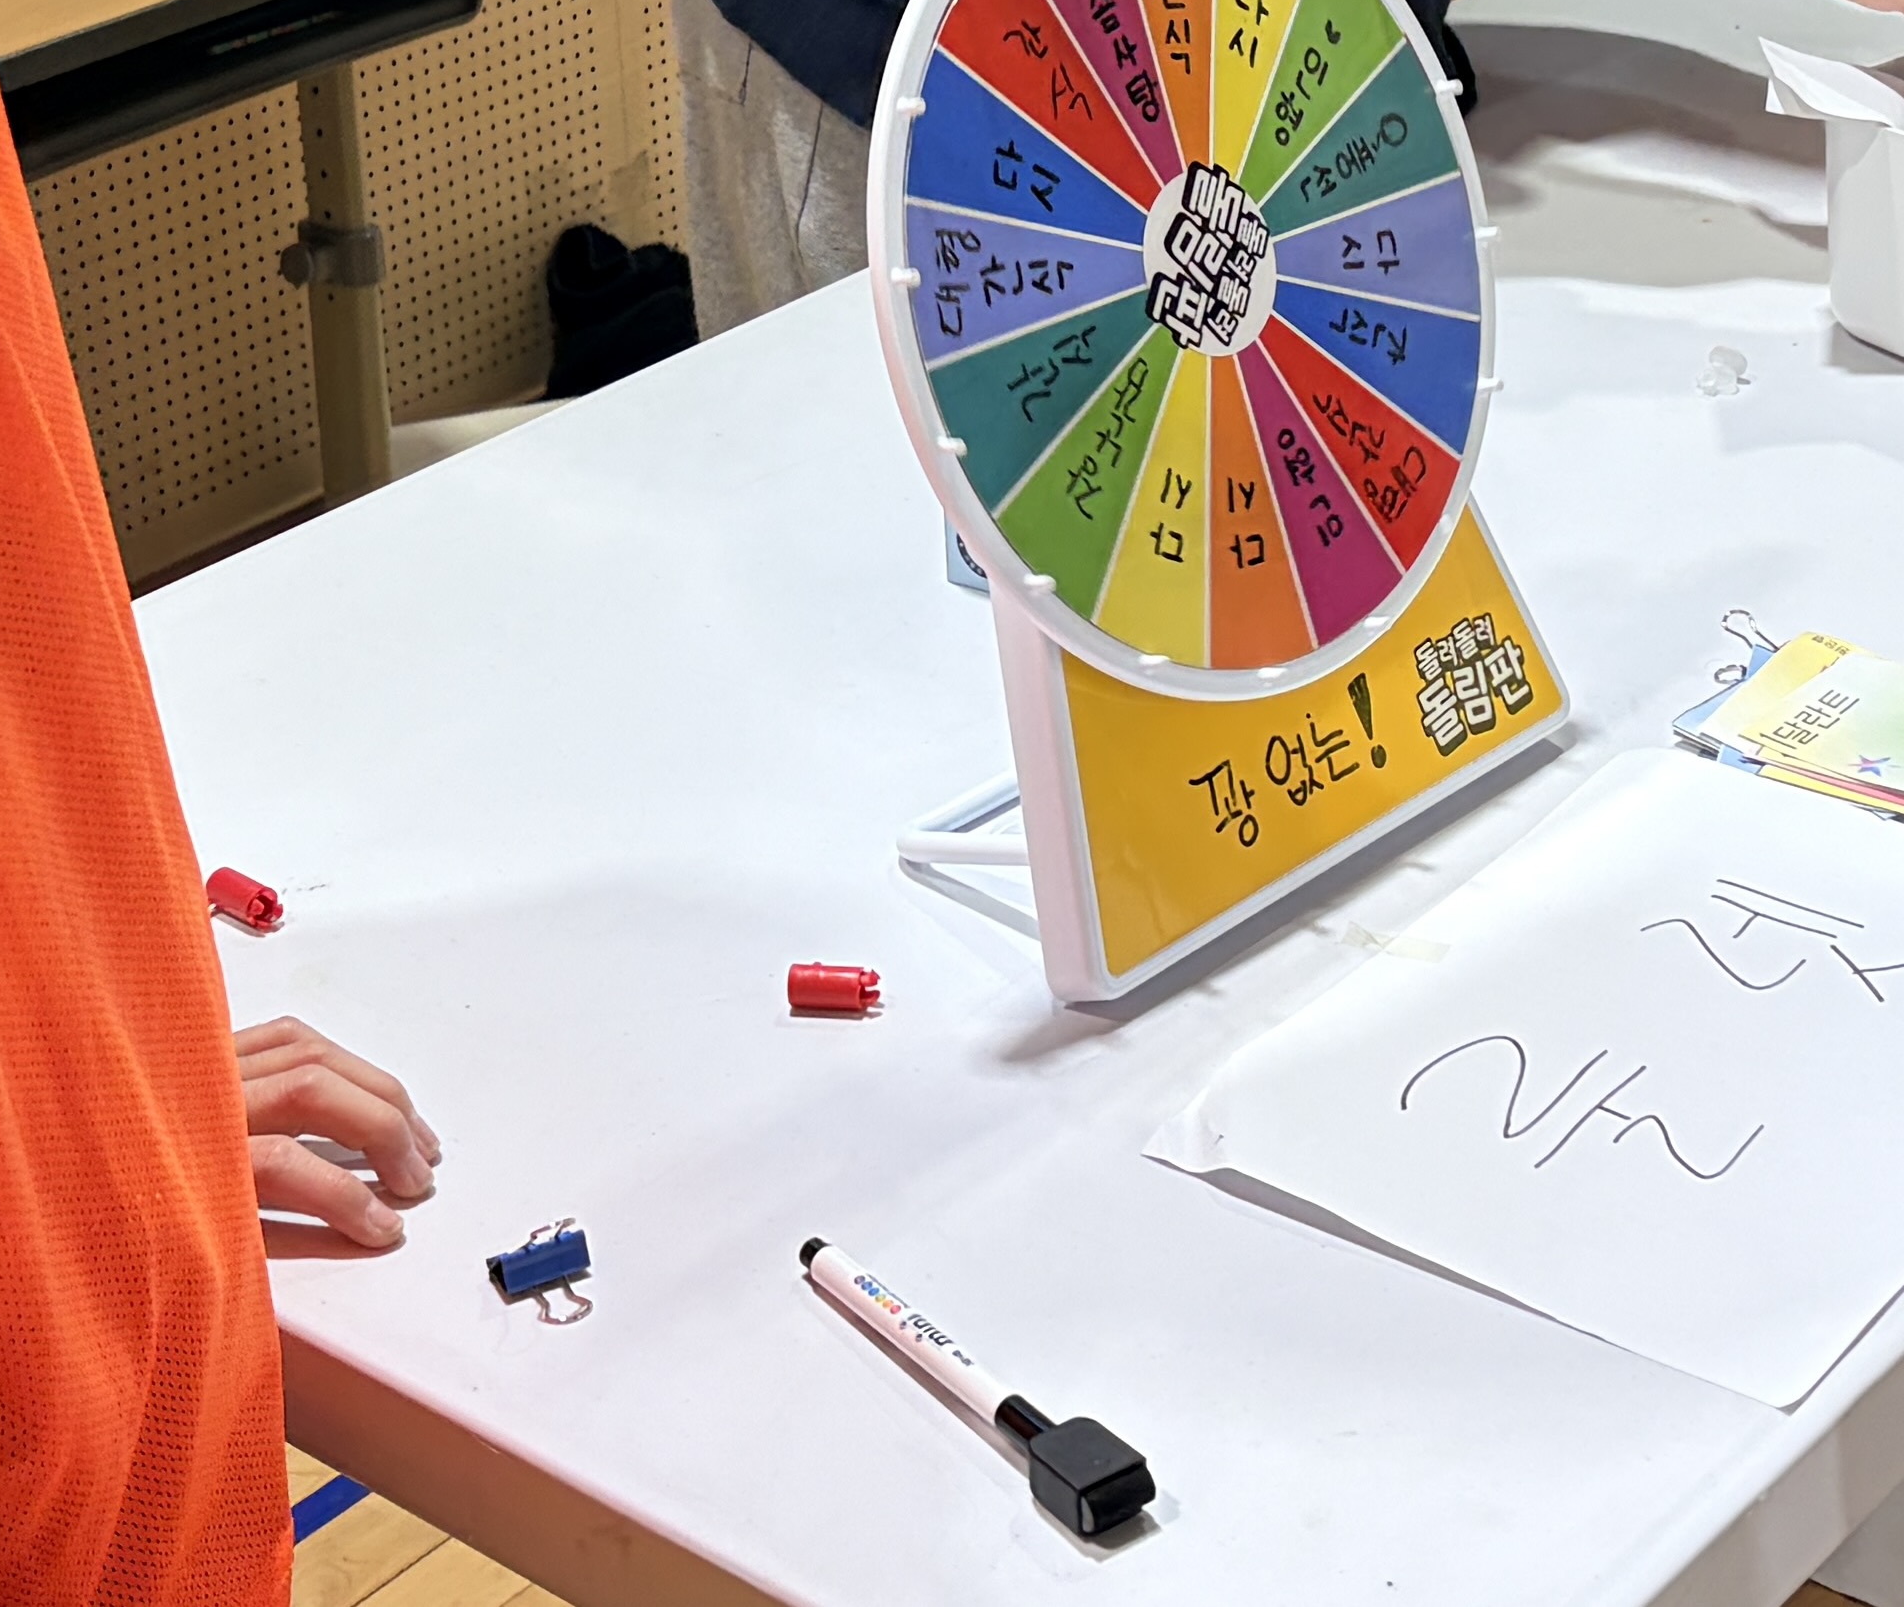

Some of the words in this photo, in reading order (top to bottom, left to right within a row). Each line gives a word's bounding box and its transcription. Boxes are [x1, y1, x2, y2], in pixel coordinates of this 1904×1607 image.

[1002, 20, 1094, 121] 간식
[992, 138, 1063, 213] 다시
[934, 228, 982, 338] 대형
[979, 253, 1075, 309] 간식
[1148, 162, 1245, 348] 돌림판
[1209, 212, 1270, 347] 돌려돌려
[1340, 228, 1402, 277] 다시
[1006, 324, 1098, 424] 간식
[1328, 306, 1408, 366] 간식
[1065, 356, 1150, 522] 장난감
[1311, 392, 1387, 467] 간식
[1148, 466, 1194, 564] 다시
[1226, 475, 1265, 570] 다시
[1362, 444, 1427, 525] 대형
[1415, 613, 1497, 682] 돌려돌려
[1418, 636, 1534, 756] 돌림판
[1188, 758, 1260, 848] 꽝
[1264, 672, 1388, 807] 없는!
[899, 1313, 954, 1347] mini
